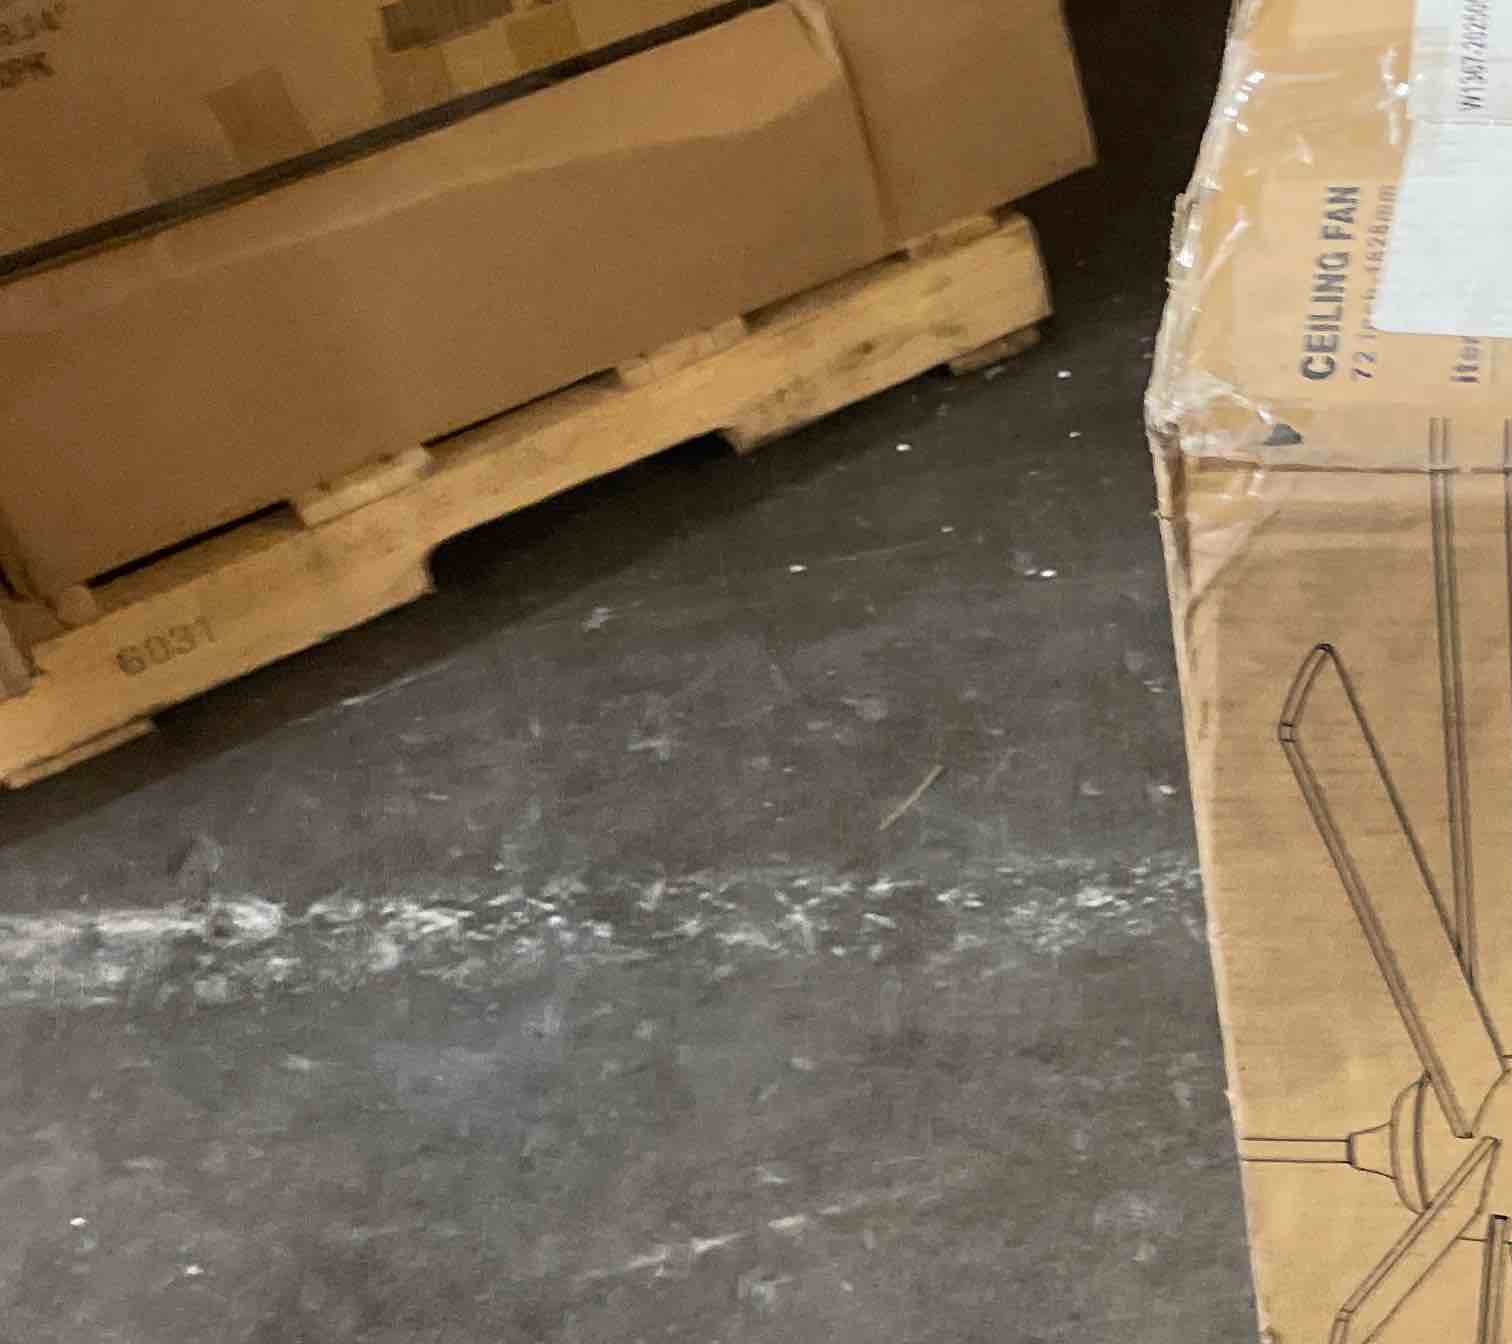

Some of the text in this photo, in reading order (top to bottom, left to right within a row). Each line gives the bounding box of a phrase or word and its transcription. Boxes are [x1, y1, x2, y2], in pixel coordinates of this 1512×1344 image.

[1300, 186, 1361, 381] CEILING FAN
[1351, 351, 1375, 383] 72
[1451, 335, 1480, 384] Ite
